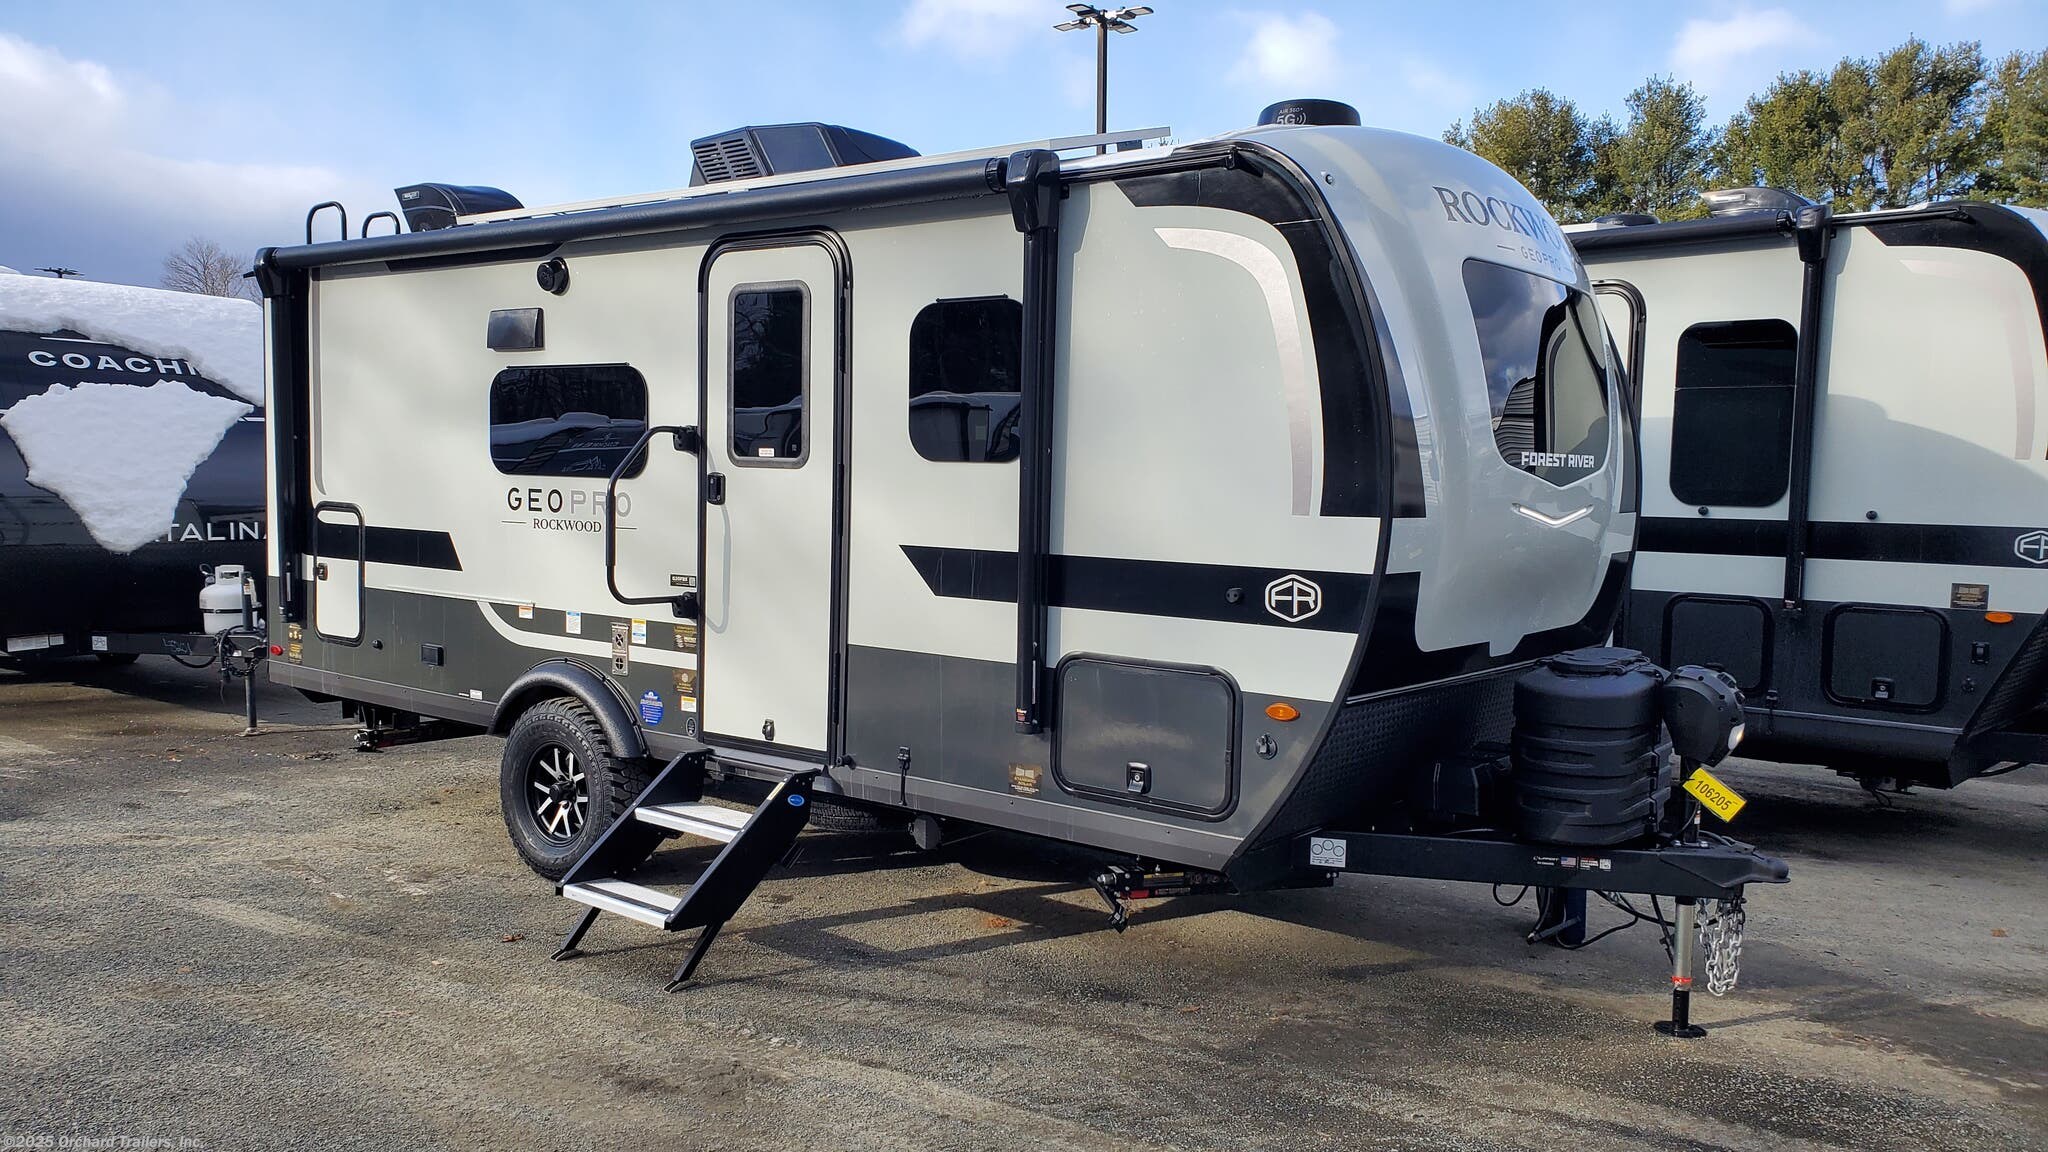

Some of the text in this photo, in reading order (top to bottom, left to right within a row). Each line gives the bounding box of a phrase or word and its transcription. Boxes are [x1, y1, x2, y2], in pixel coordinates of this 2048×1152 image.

[1276, 113, 1296, 125] 5G
[1432, 185, 1570, 257] ROCKWO
[1521, 451, 1595, 468] FOREST RIVER
[156, 522, 267, 541] TALIN
[533, 518, 602, 533] ROCKWOOD
[1694, 780, 1732, 811] 106205
